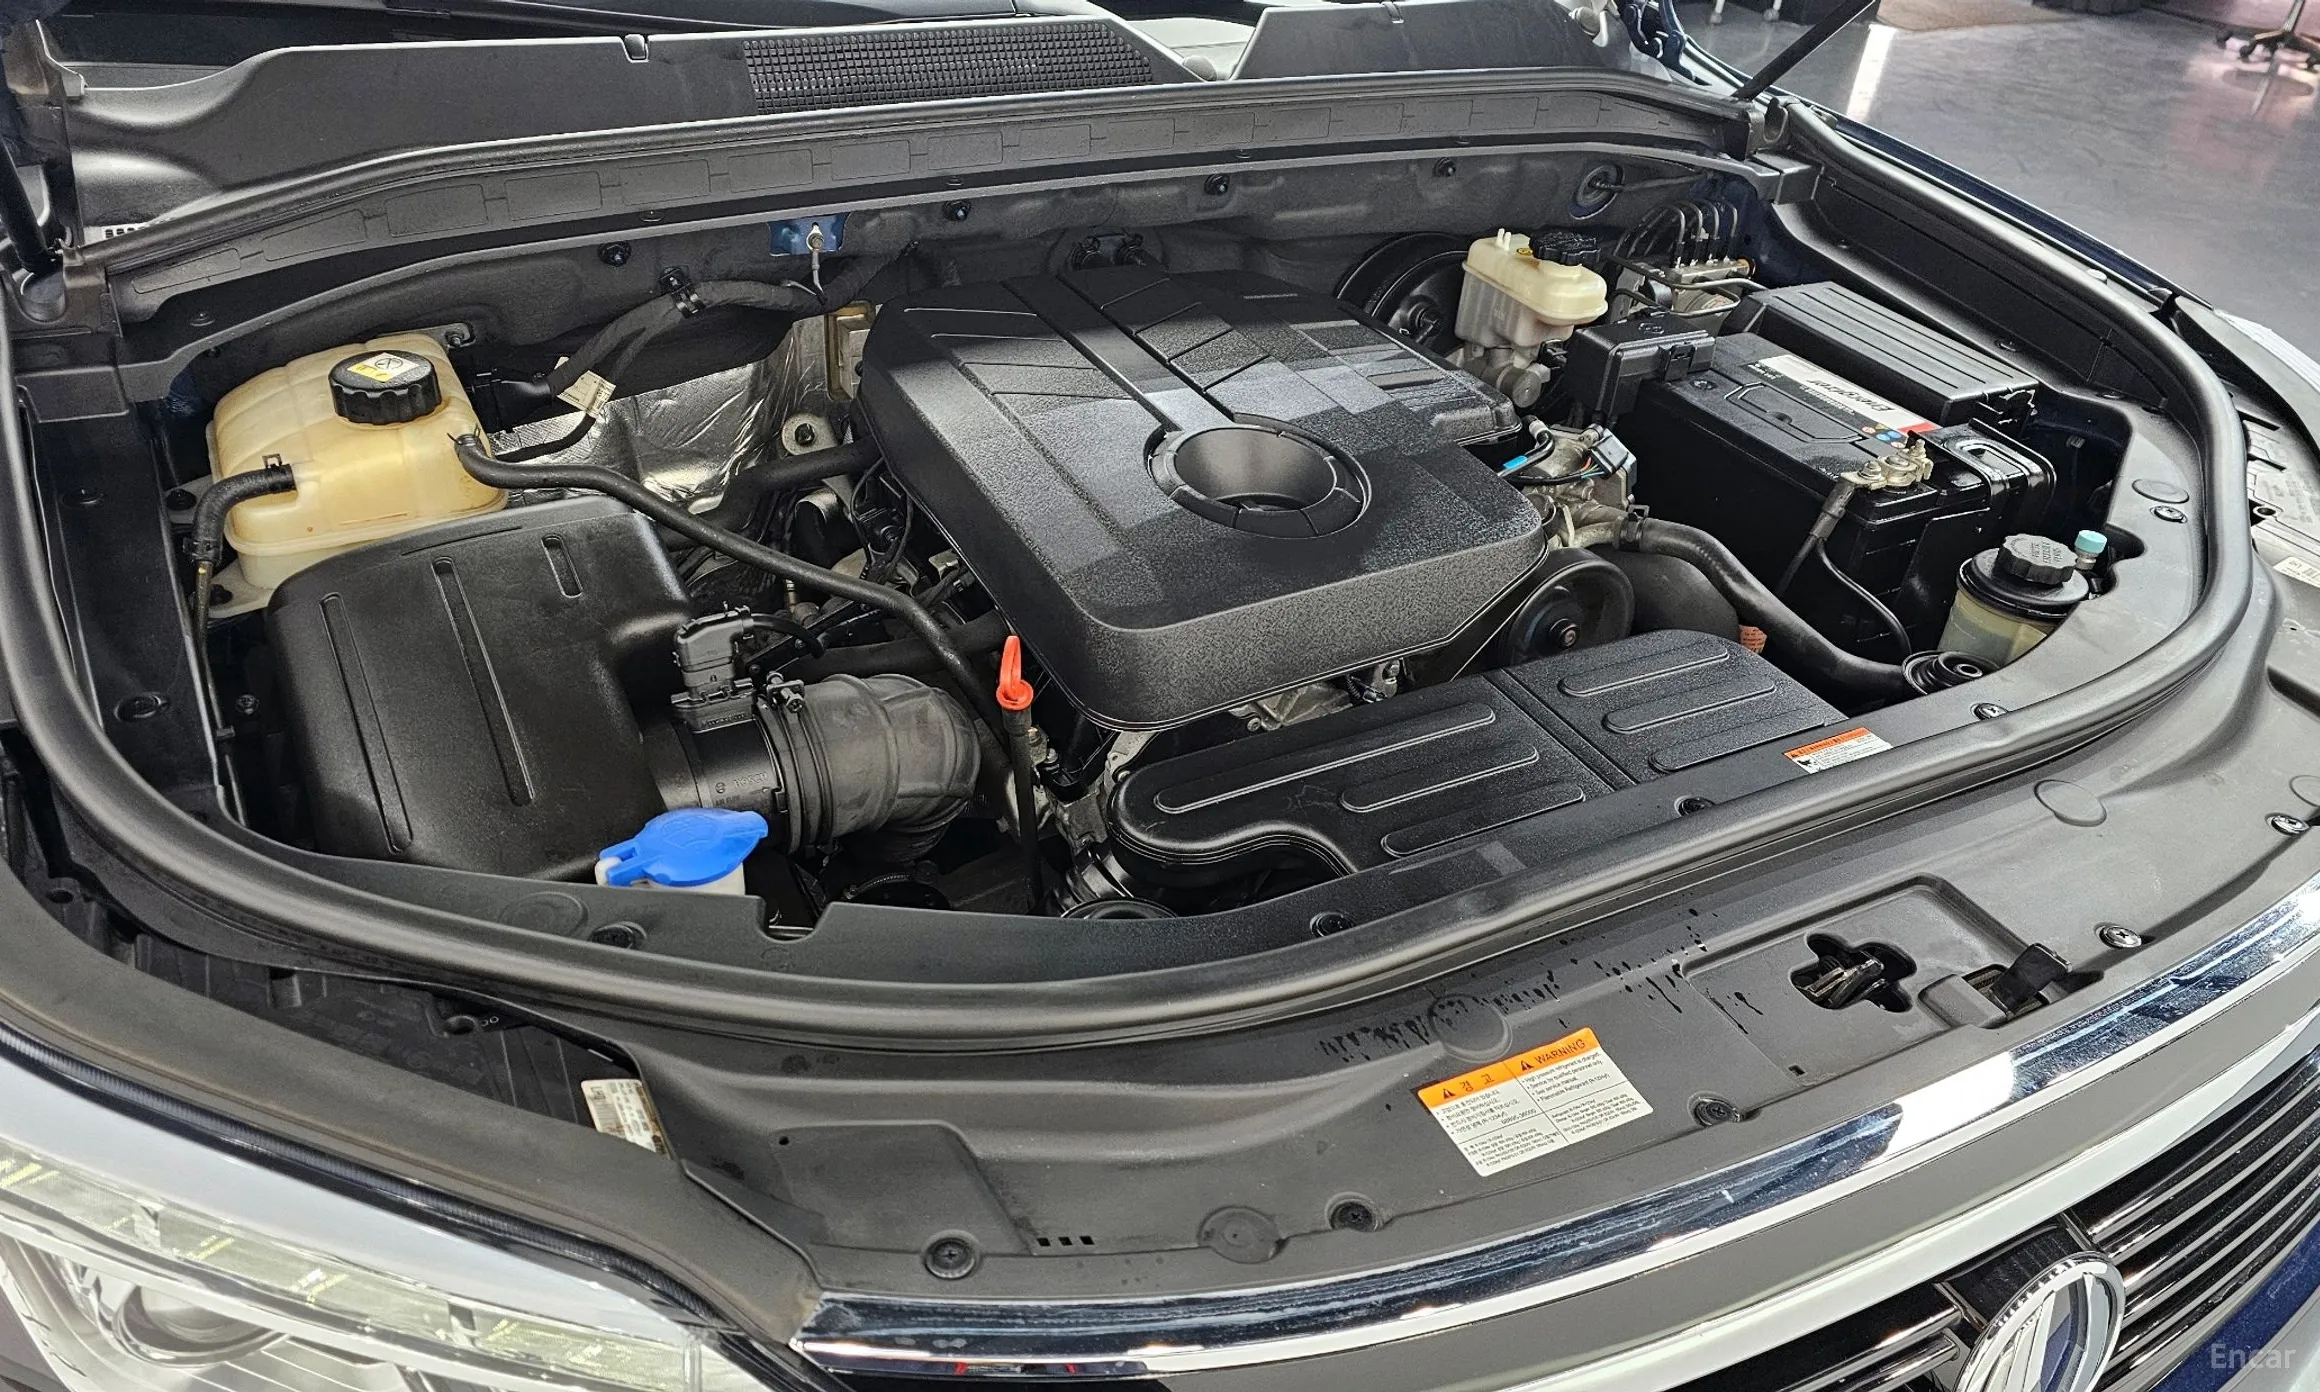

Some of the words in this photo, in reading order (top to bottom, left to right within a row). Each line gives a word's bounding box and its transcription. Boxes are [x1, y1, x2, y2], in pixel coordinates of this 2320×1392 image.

[1533, 1038, 1587, 1064] WARNING
[1458, 1079, 1474, 1093] 경
[1479, 1072, 1495, 1084] 고
